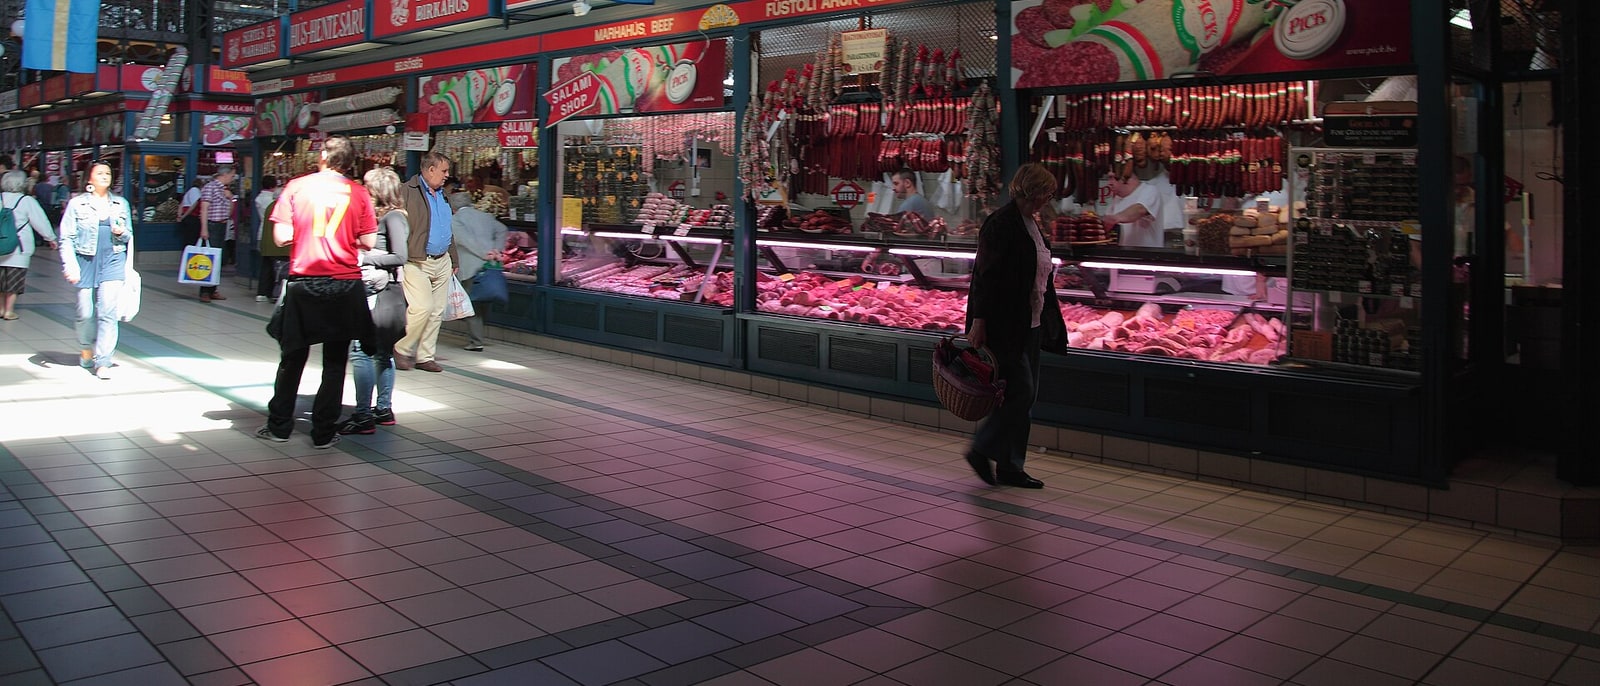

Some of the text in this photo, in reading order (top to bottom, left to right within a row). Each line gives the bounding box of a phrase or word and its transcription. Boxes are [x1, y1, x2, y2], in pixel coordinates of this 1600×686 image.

[651, 18, 674, 33] BEEF
[1288, 10, 1327, 36] PICK
[552, 75, 592, 104] SALAMI
[560, 94, 588, 116] SHOP
[502, 121, 532, 133] SALAMI
[506, 135, 528, 146] SHOP
[312, 192, 351, 237] 17
